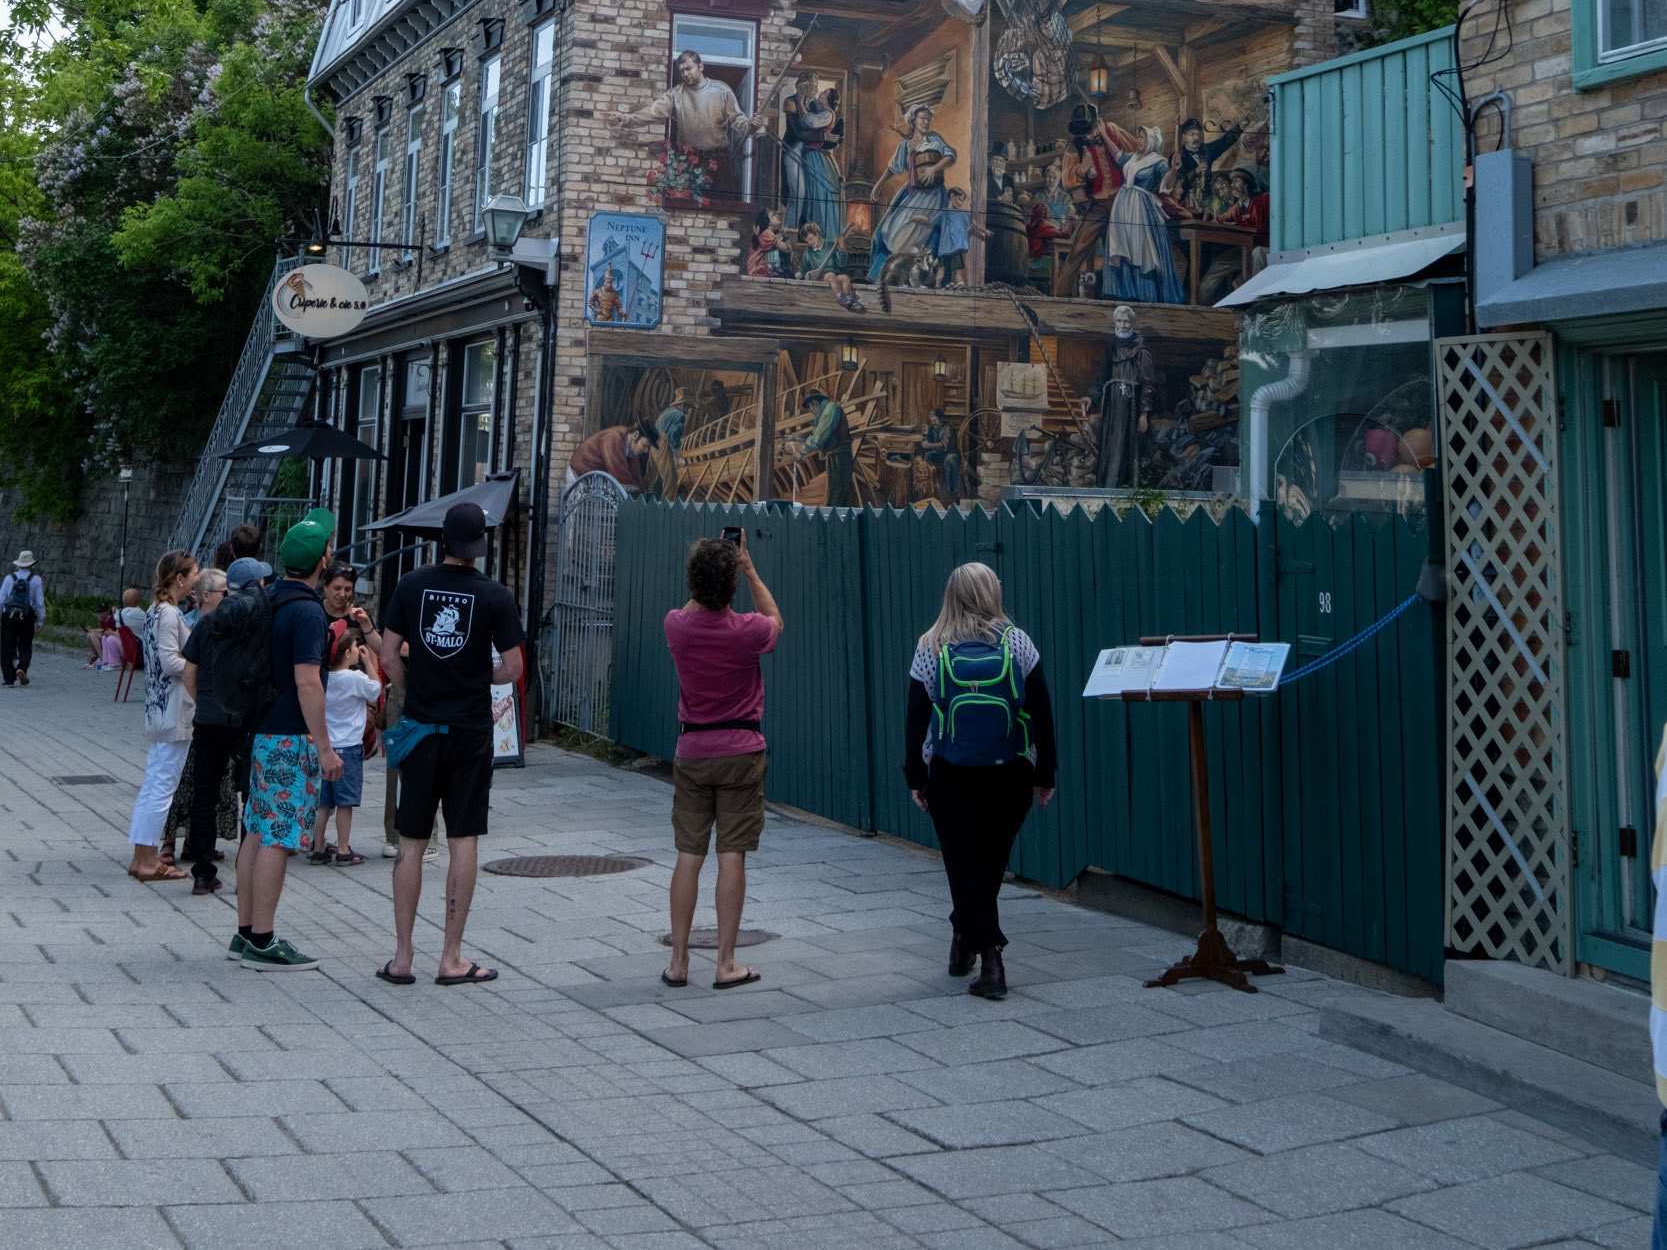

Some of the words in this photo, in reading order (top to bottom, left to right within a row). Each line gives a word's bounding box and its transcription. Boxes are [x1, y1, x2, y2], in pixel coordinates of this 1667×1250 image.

[625, 234, 640, 242] INN
[330, 297, 337, 309] &
[429, 594, 468, 605] BISTRO
[1319, 592, 1331, 613] 98
